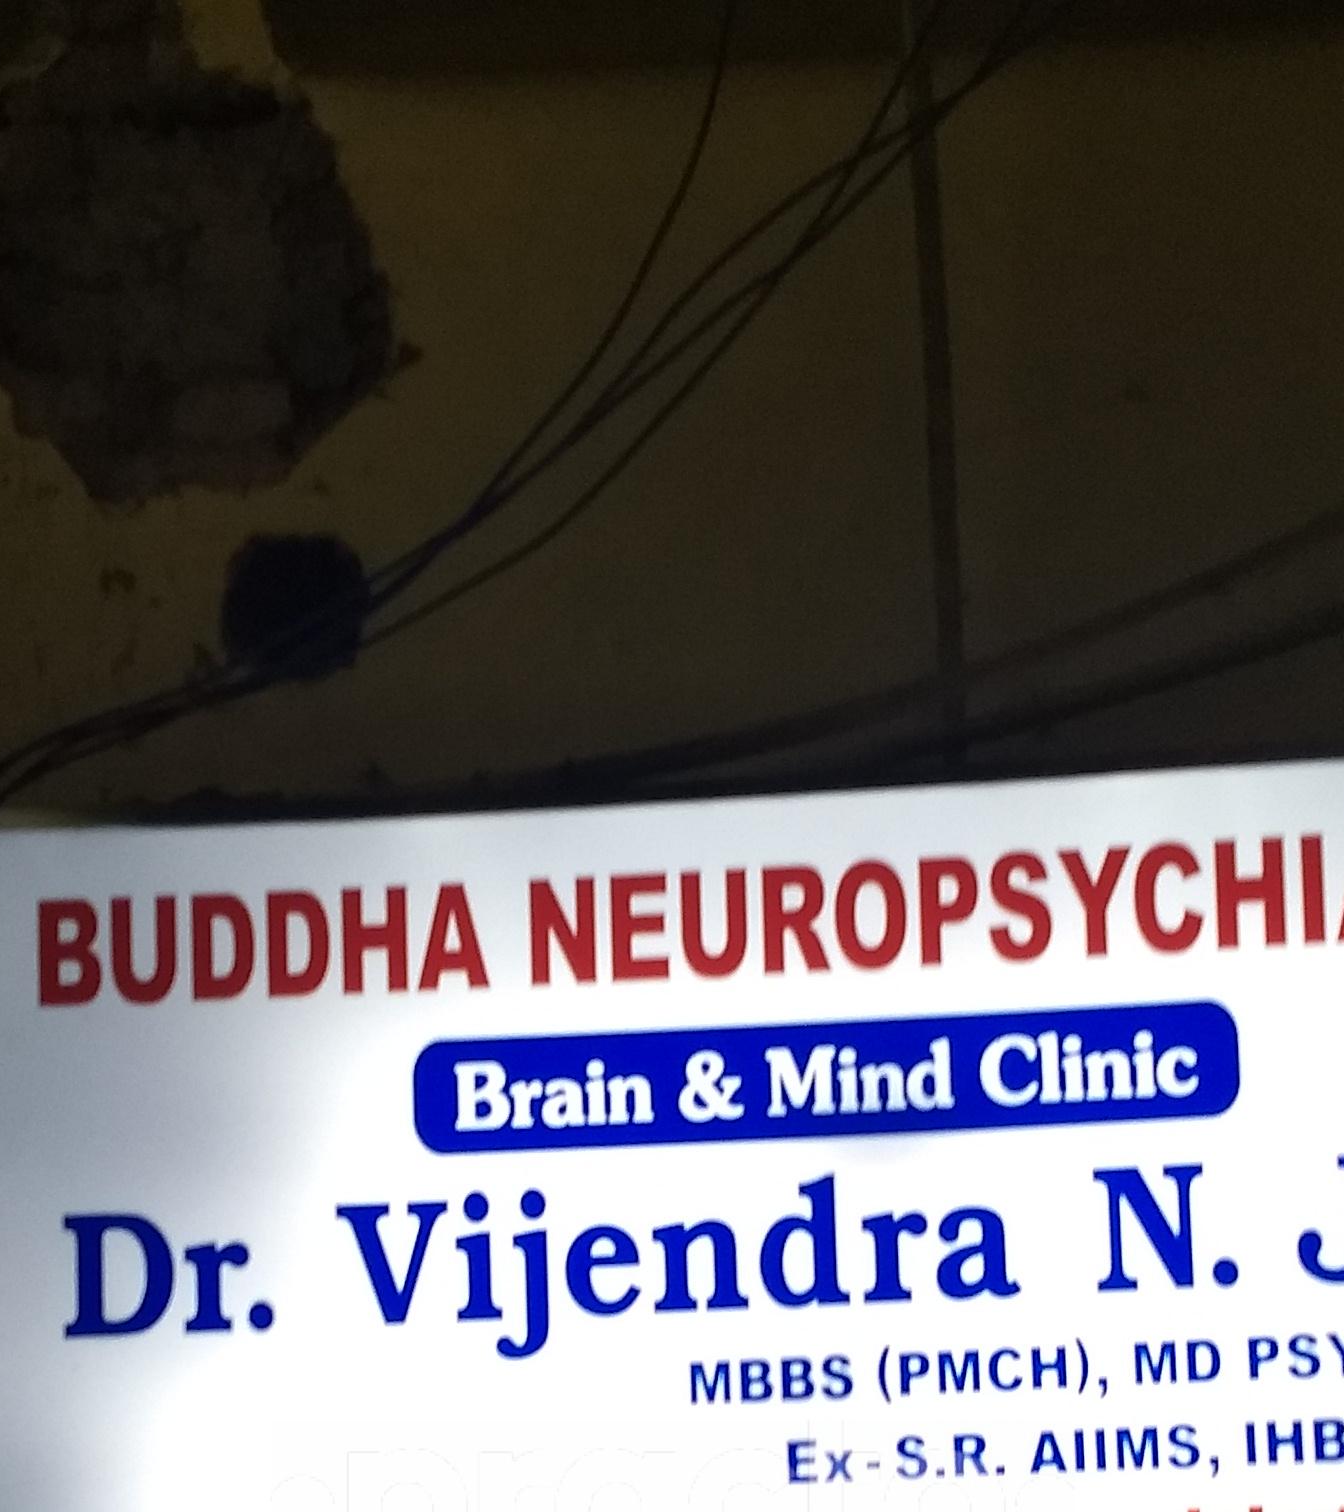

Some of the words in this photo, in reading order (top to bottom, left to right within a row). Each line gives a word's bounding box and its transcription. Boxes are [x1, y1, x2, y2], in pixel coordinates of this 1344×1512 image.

[37, 882, 490, 1007] BUDDHA
[453, 1058, 655, 1133] Brain
[678, 1050, 744, 1122] &
[764, 1038, 956, 1117] Mind
[978, 1029, 1199, 1109] Clinic
[63, 1211, 276, 1341] Dr.
[336, 1171, 1020, 1359] Vijendra
[1093, 1160, 1241, 1296] N.
[688, 1355, 856, 1405] MBBS
[876, 1337, 1110, 1402] (PMCH),
[1133, 1339, 1222, 1386] MD
[1029, 1424, 1222, 1476] AIIMS,
